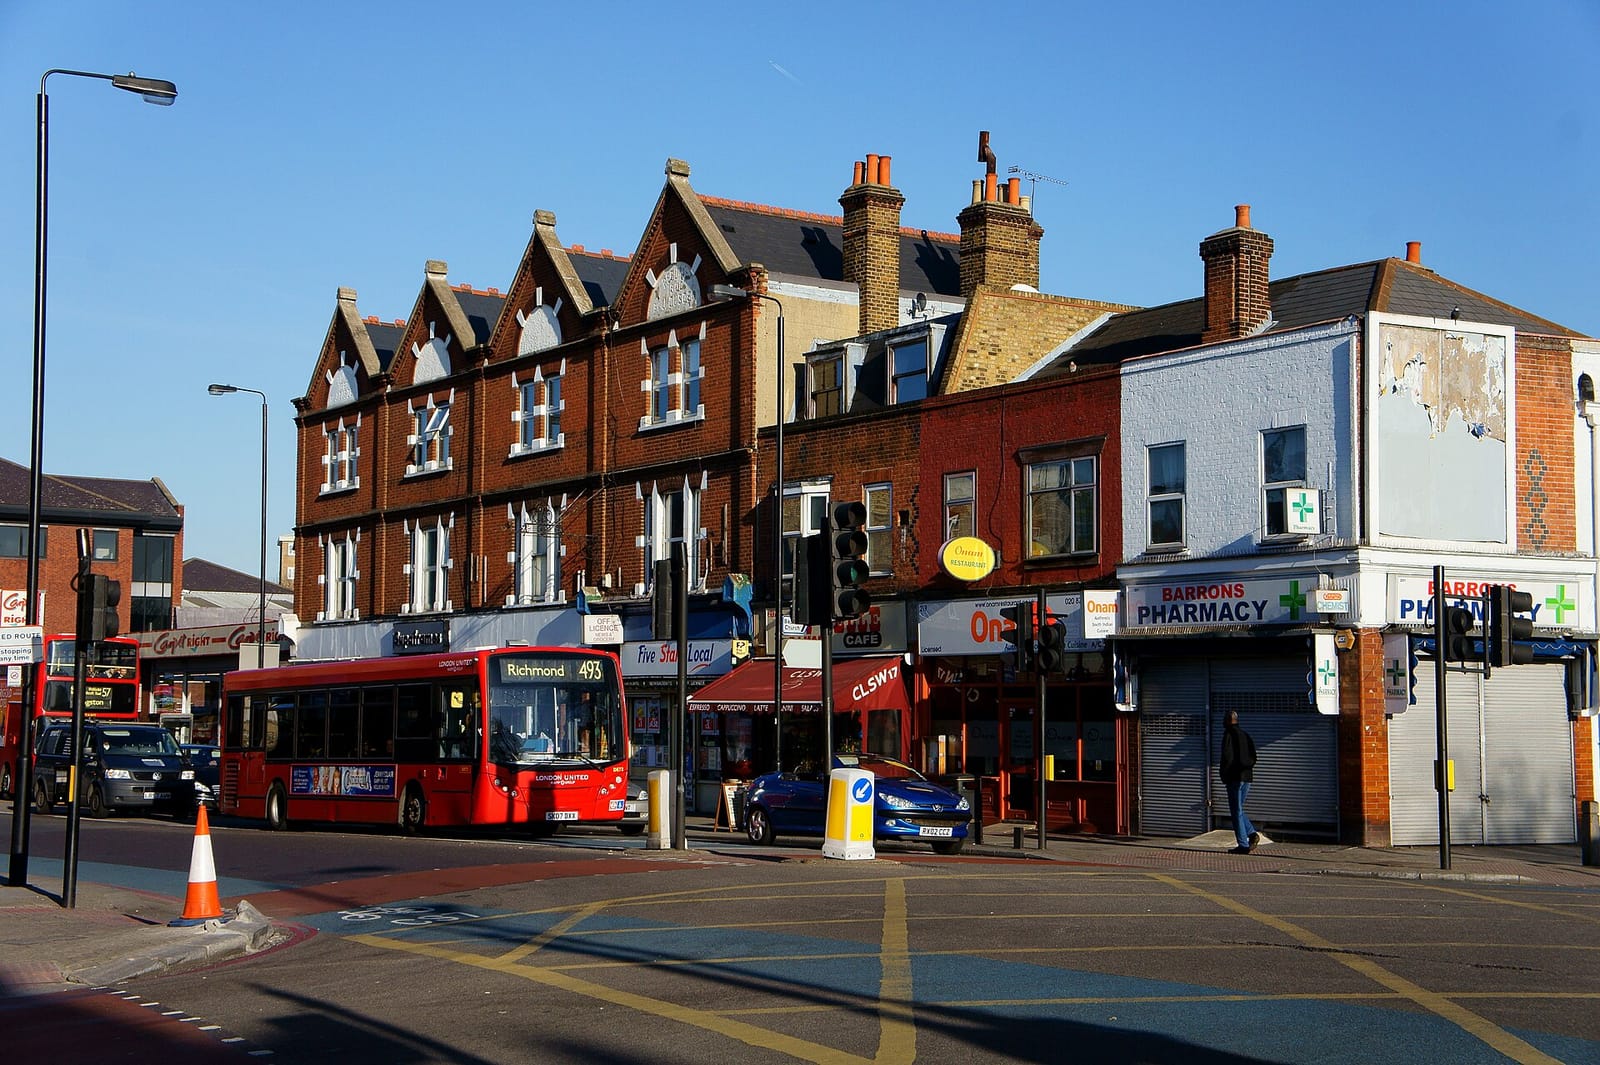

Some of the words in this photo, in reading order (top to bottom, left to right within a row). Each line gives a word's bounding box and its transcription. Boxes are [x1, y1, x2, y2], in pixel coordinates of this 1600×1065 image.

[954, 545, 983, 557] Onam
[950, 559, 986, 569] RESTAURANT
[1162, 583, 1245, 601] BARRONS
[1427, 581, 1517, 597] ARROS
[3, 593, 26, 611] Carp
[1087, 600, 1119, 613] Onam
[1317, 601, 1349, 611] CHEMIST
[1137, 600, 1269, 625] PHARMACY
[970, 610, 1017, 643] Ona
[14, 632, 41, 640] ROUTE
[845, 634, 879, 645] CAFE
[153, 632, 187, 654] Carpet
[638, 644, 656, 663] Five
[688, 643, 715, 663] Local
[507, 663, 565, 677] Richmond
[579, 660, 602, 680] 493
[101, 687, 111, 697] 57
[689, 703, 710, 711] ESPRESSO
[564, 773, 589, 781] UNITED
